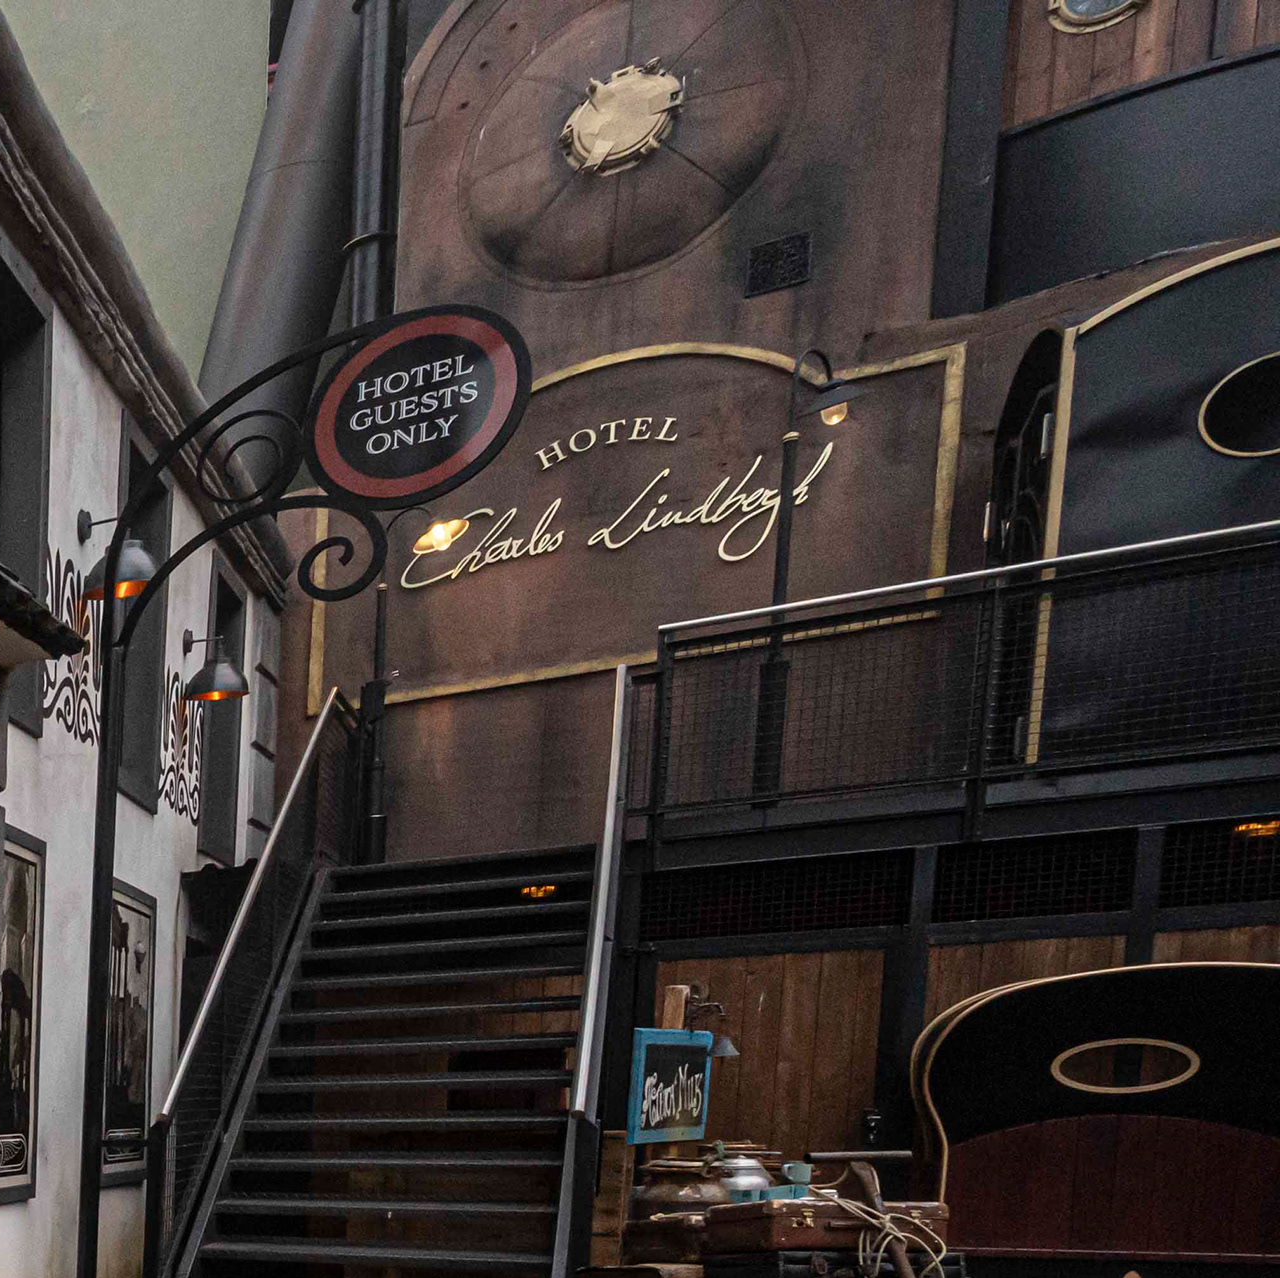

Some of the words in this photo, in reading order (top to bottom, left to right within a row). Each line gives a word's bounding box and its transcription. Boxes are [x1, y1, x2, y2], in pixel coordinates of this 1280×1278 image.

[356, 354, 475, 403] HOTEL
[349, 381, 478, 431] GUESTS
[365, 414, 459, 455] ONLY
[535, 416, 679, 471] HOTEL
[401, 498, 565, 589] Charles
[587, 442, 834, 562] Lindbergh
